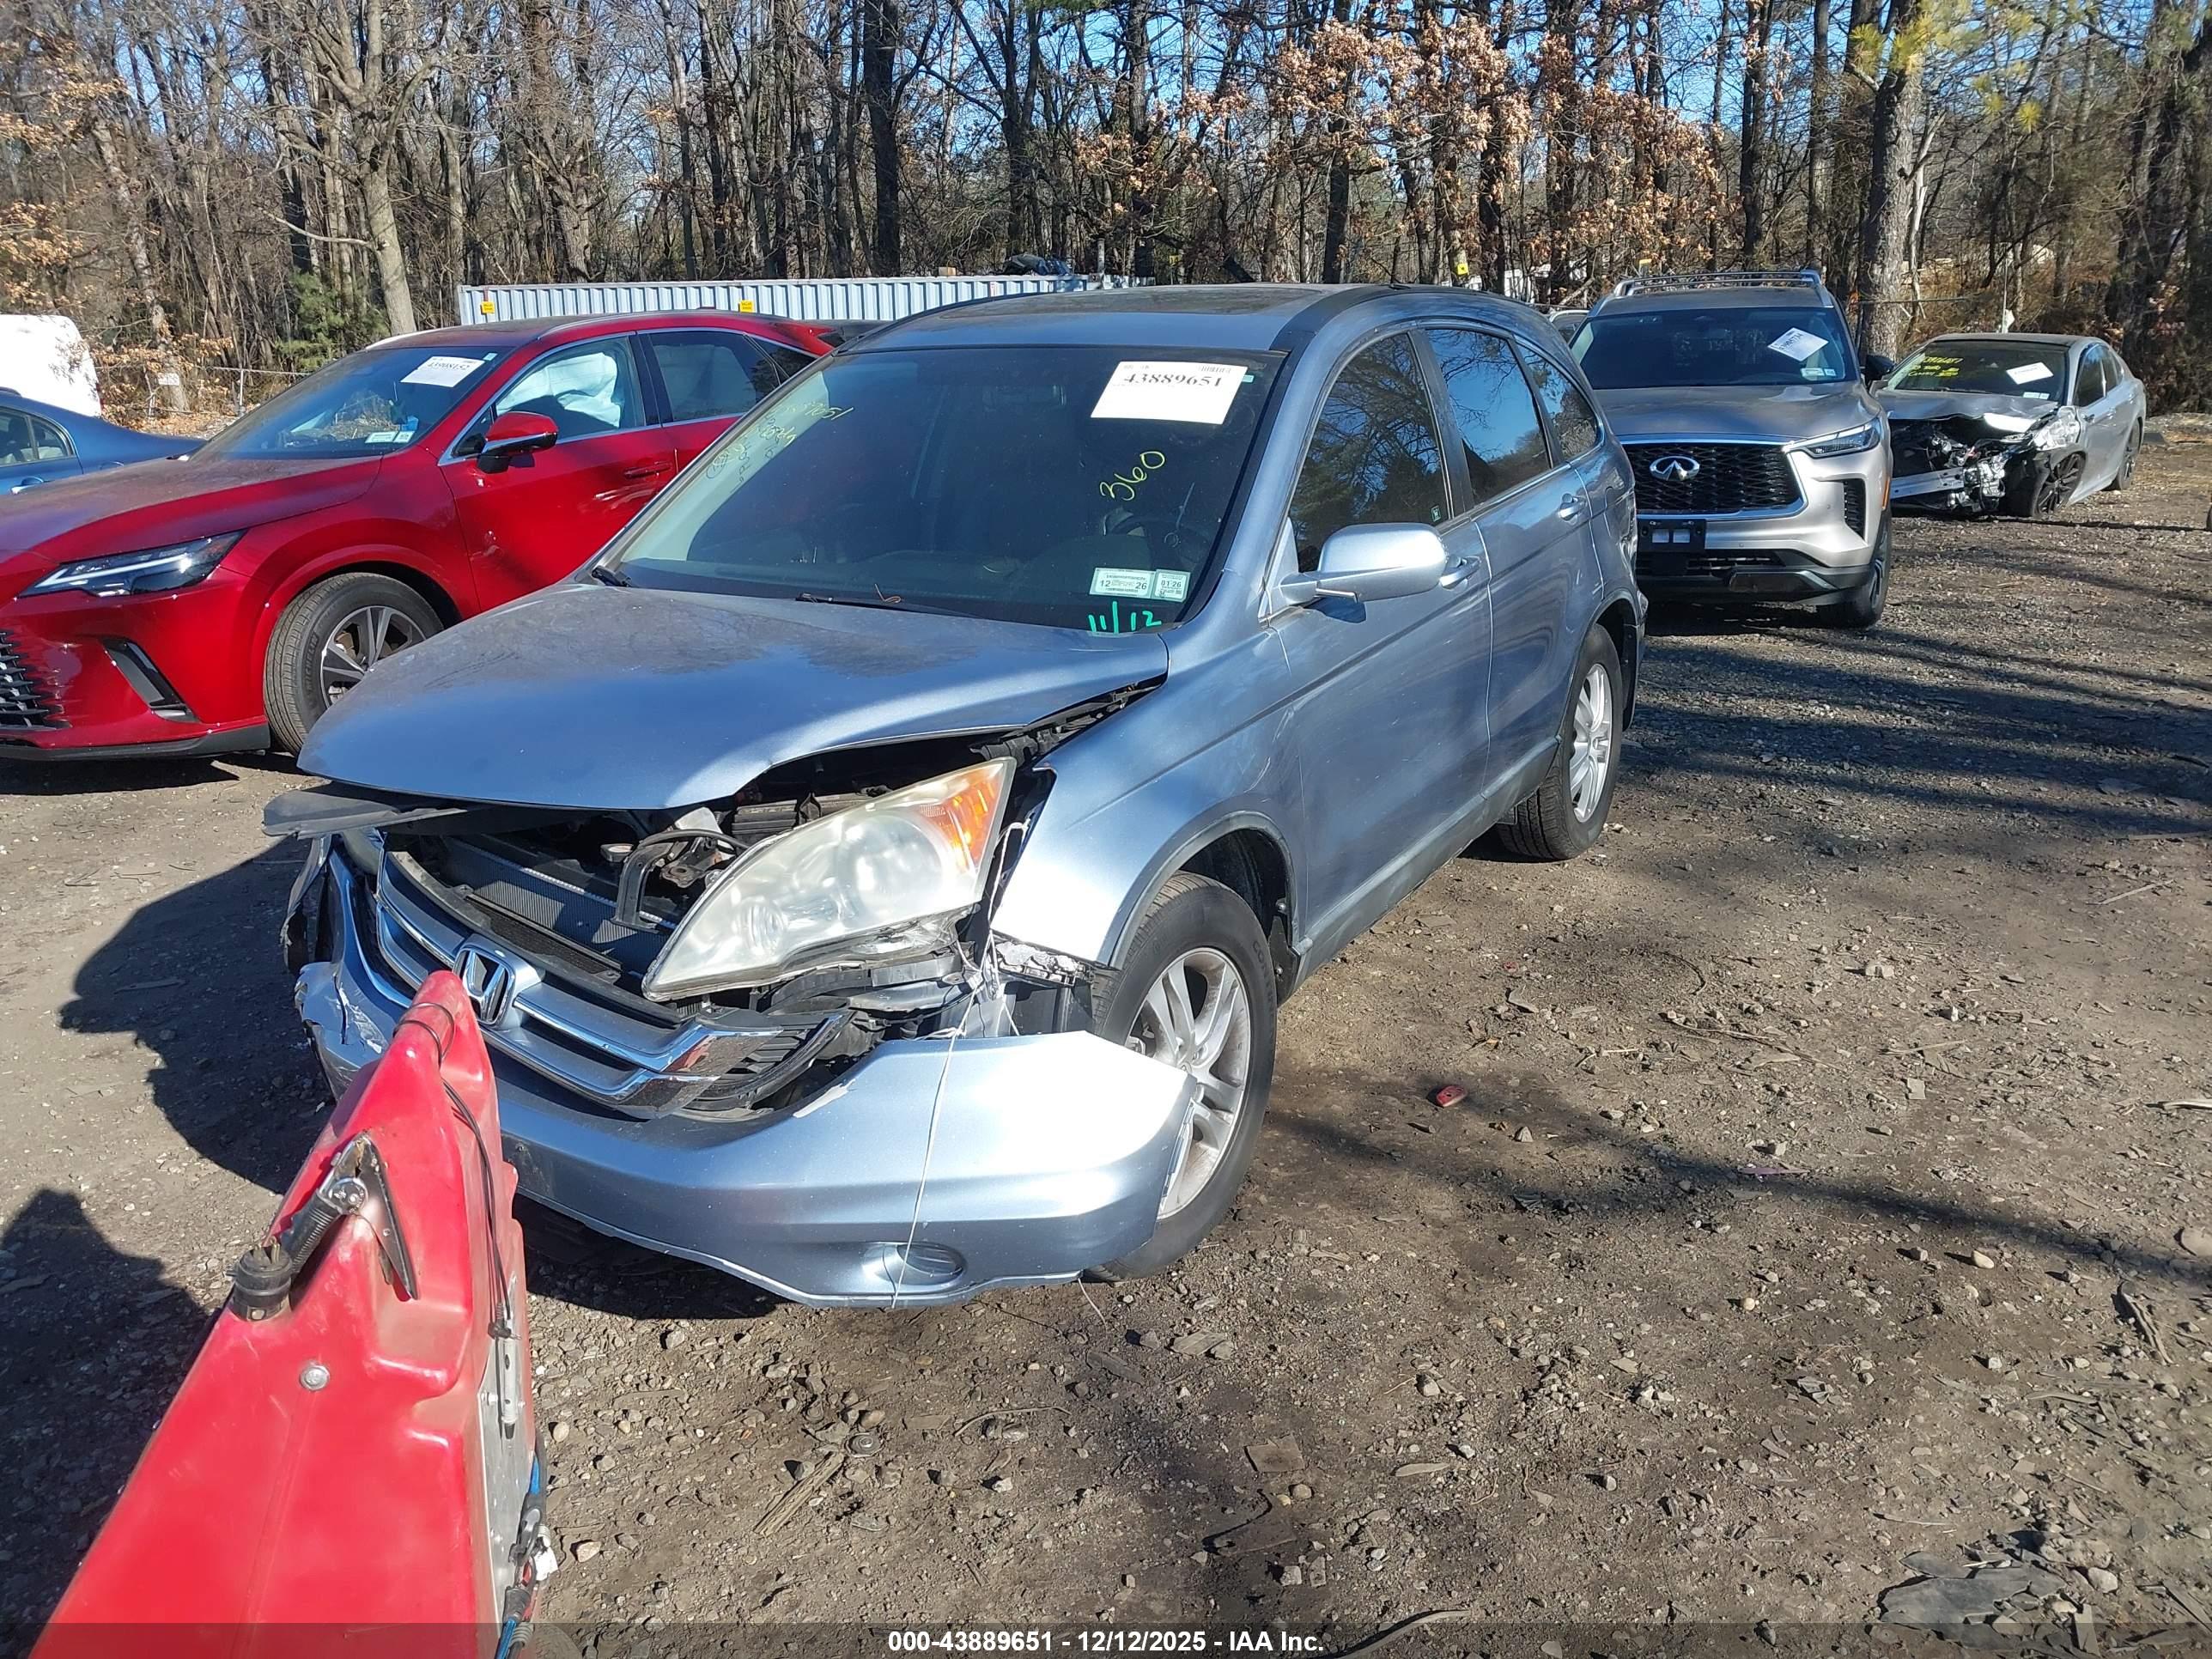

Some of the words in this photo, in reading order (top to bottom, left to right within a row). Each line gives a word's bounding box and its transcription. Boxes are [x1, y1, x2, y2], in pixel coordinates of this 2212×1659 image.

[1123, 373, 1222, 387] 43889651
[1099, 450, 1167, 501] 360
[1135, 581, 1147, 590] 26
[1088, 600, 1163, 635] 11/12
